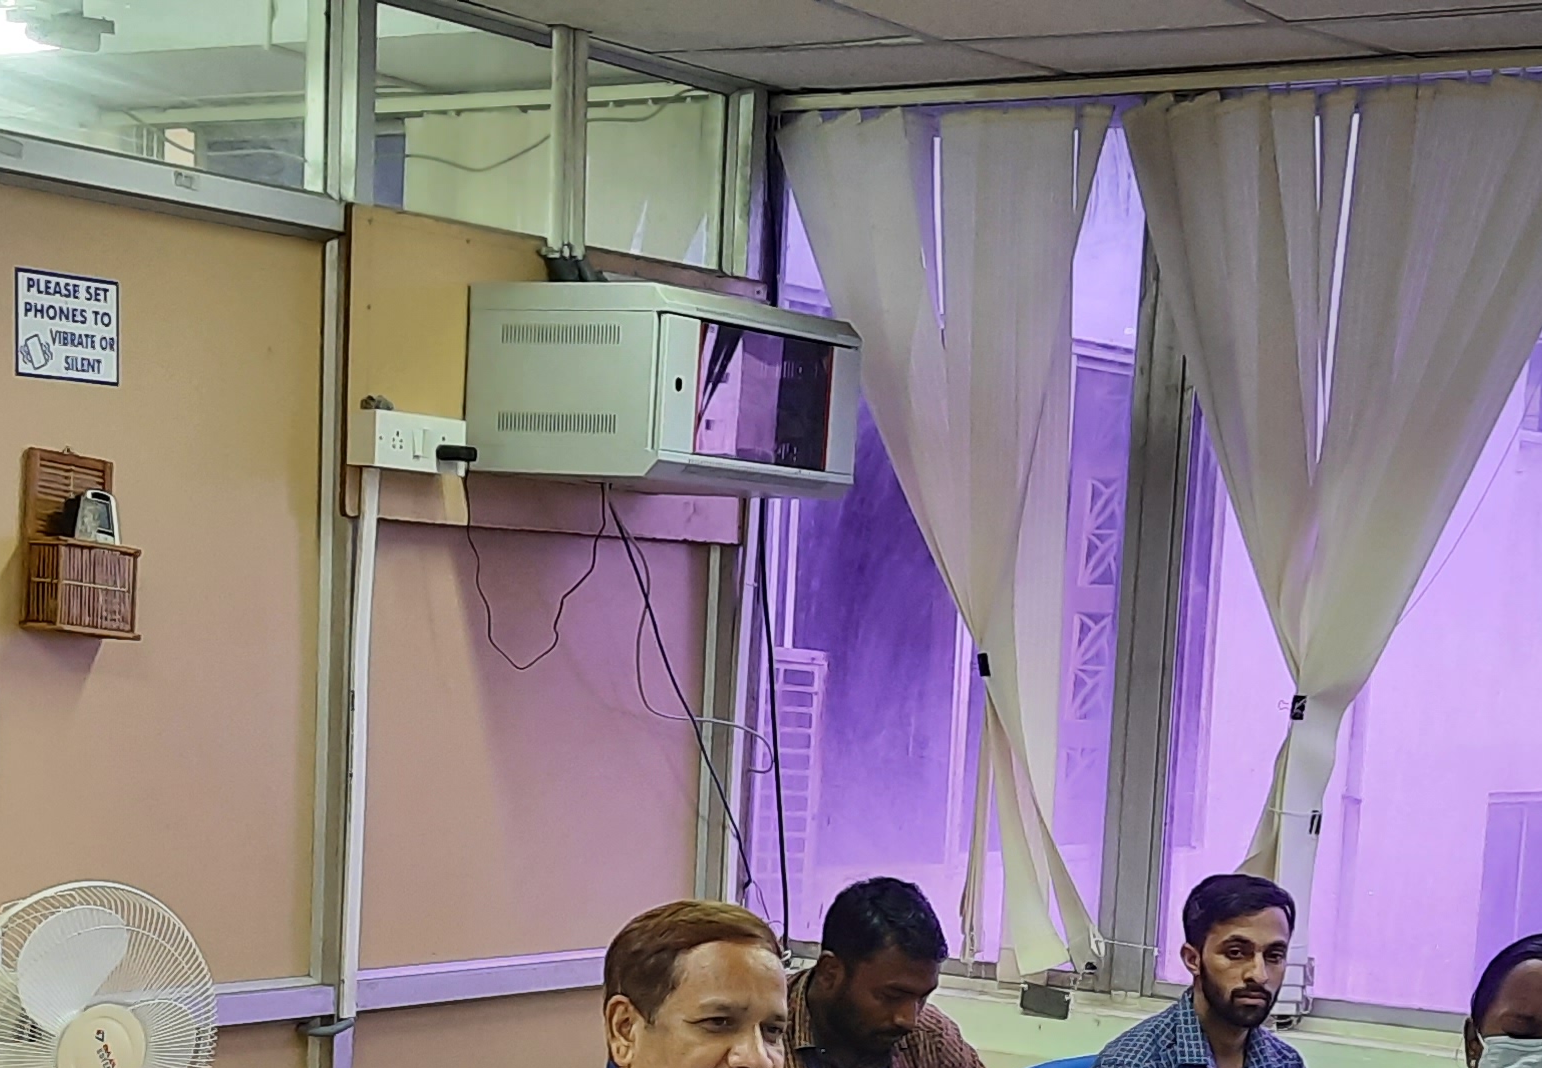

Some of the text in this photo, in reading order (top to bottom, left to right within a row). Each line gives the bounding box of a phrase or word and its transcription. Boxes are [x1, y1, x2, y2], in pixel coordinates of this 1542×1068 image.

[26, 277, 109, 304] PLEASE SET
[23, 301, 112, 328] PHONES TO
[50, 328, 115, 352] VIBRATE OR
[64, 355, 102, 374] SILENT
